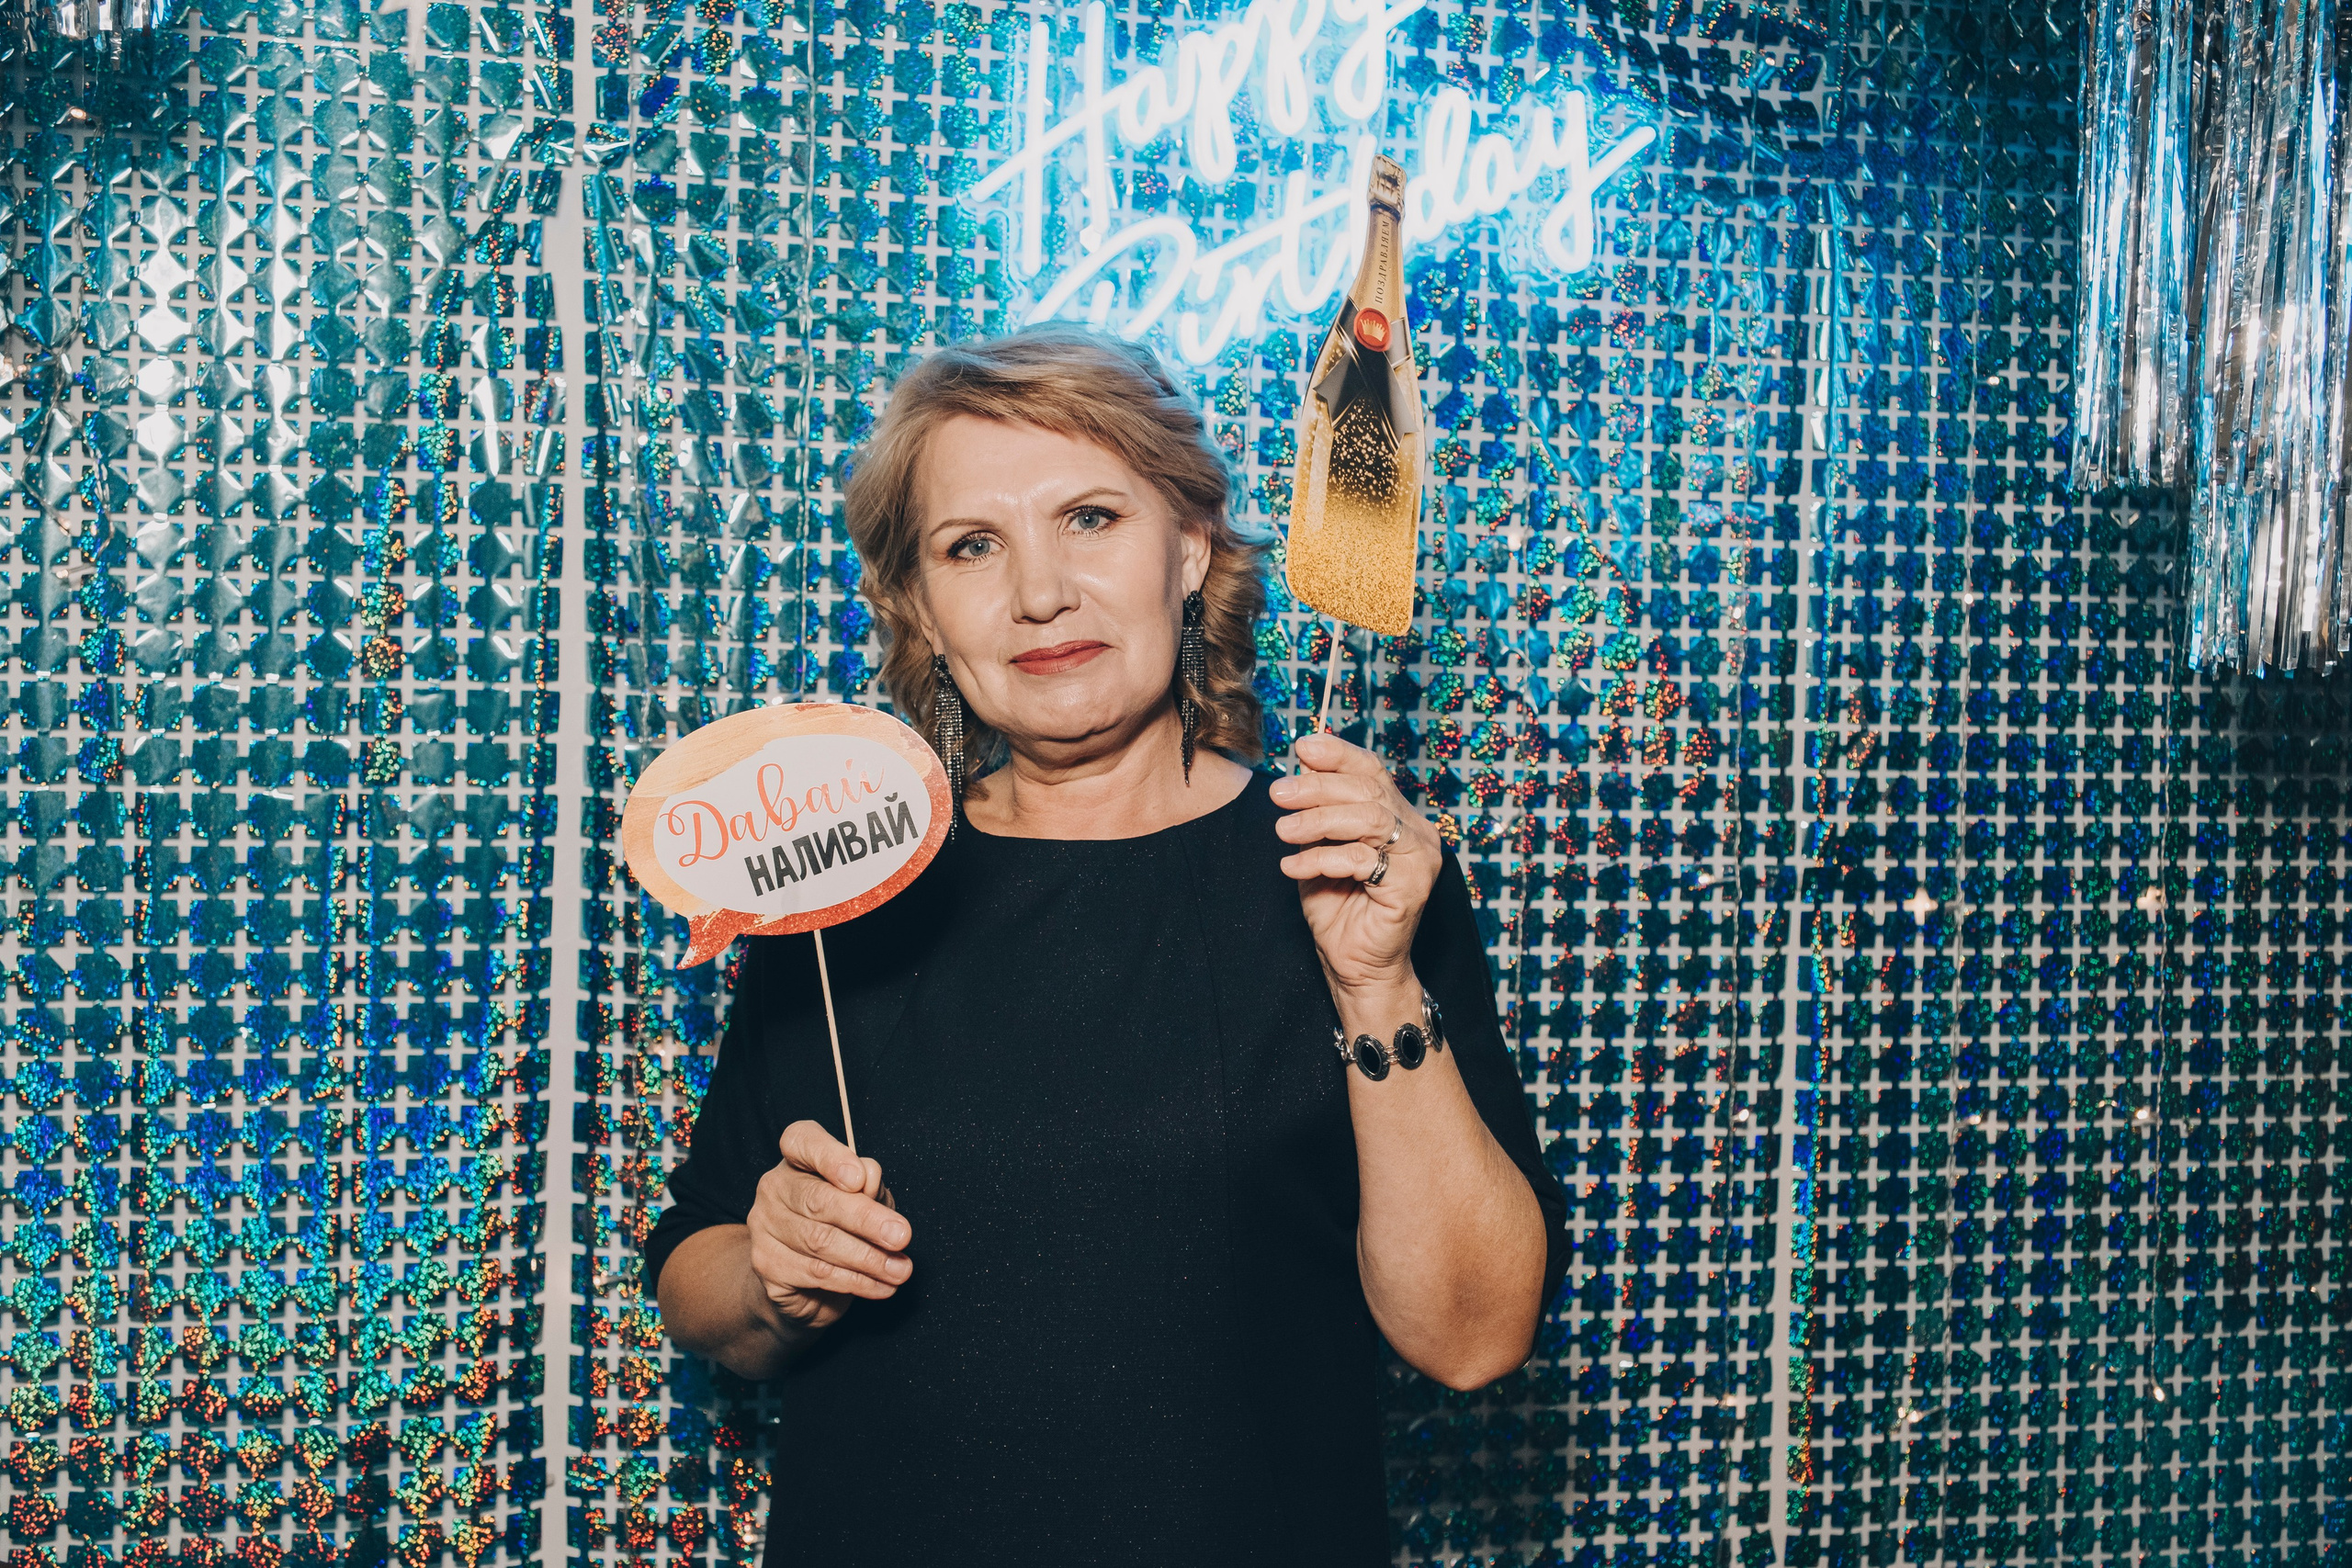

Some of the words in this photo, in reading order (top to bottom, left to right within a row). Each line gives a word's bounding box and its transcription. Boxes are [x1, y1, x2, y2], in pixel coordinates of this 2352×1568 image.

[971, 0, 1429, 276] Happy
[1374, 220, 1390, 304] ПОЗДРАВЛЯЕМ
[659, 759, 885, 868] Давай
[744, 792, 919, 897] НАЛИВАЙ
